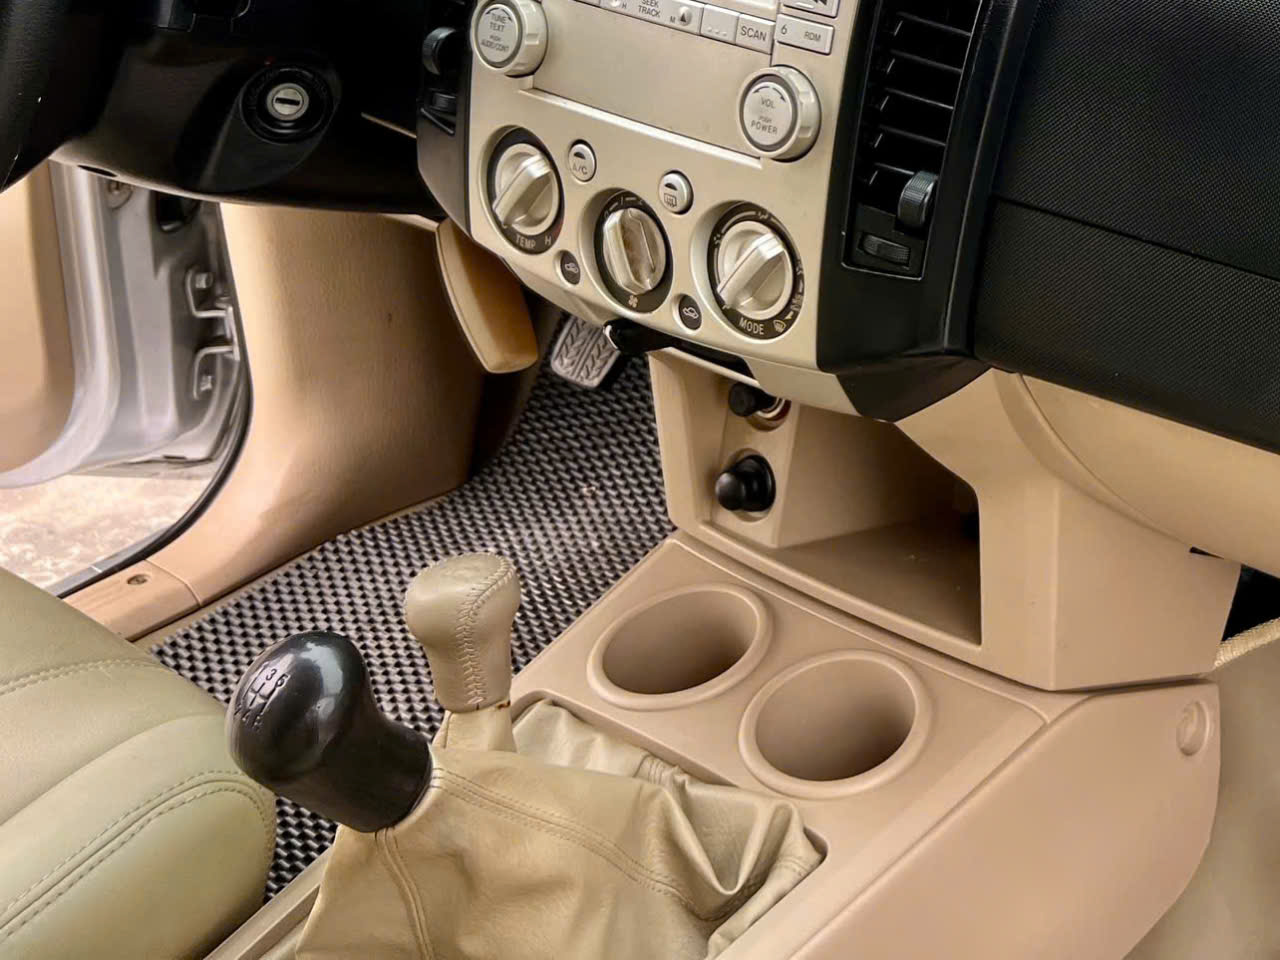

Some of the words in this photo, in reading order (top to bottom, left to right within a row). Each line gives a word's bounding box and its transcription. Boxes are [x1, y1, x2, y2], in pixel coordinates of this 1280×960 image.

[638, 5, 661, 18] TRACK
[740, 25, 767, 41] SCAN
[780, 24, 788, 35] 6
[760, 96, 776, 109] VOL
[750, 119, 778, 135] POWER
[515, 234, 537, 249] TEMP
[544, 234, 552, 246] H
[739, 317, 765, 336] MODE
[265, 668, 278, 681] 3
